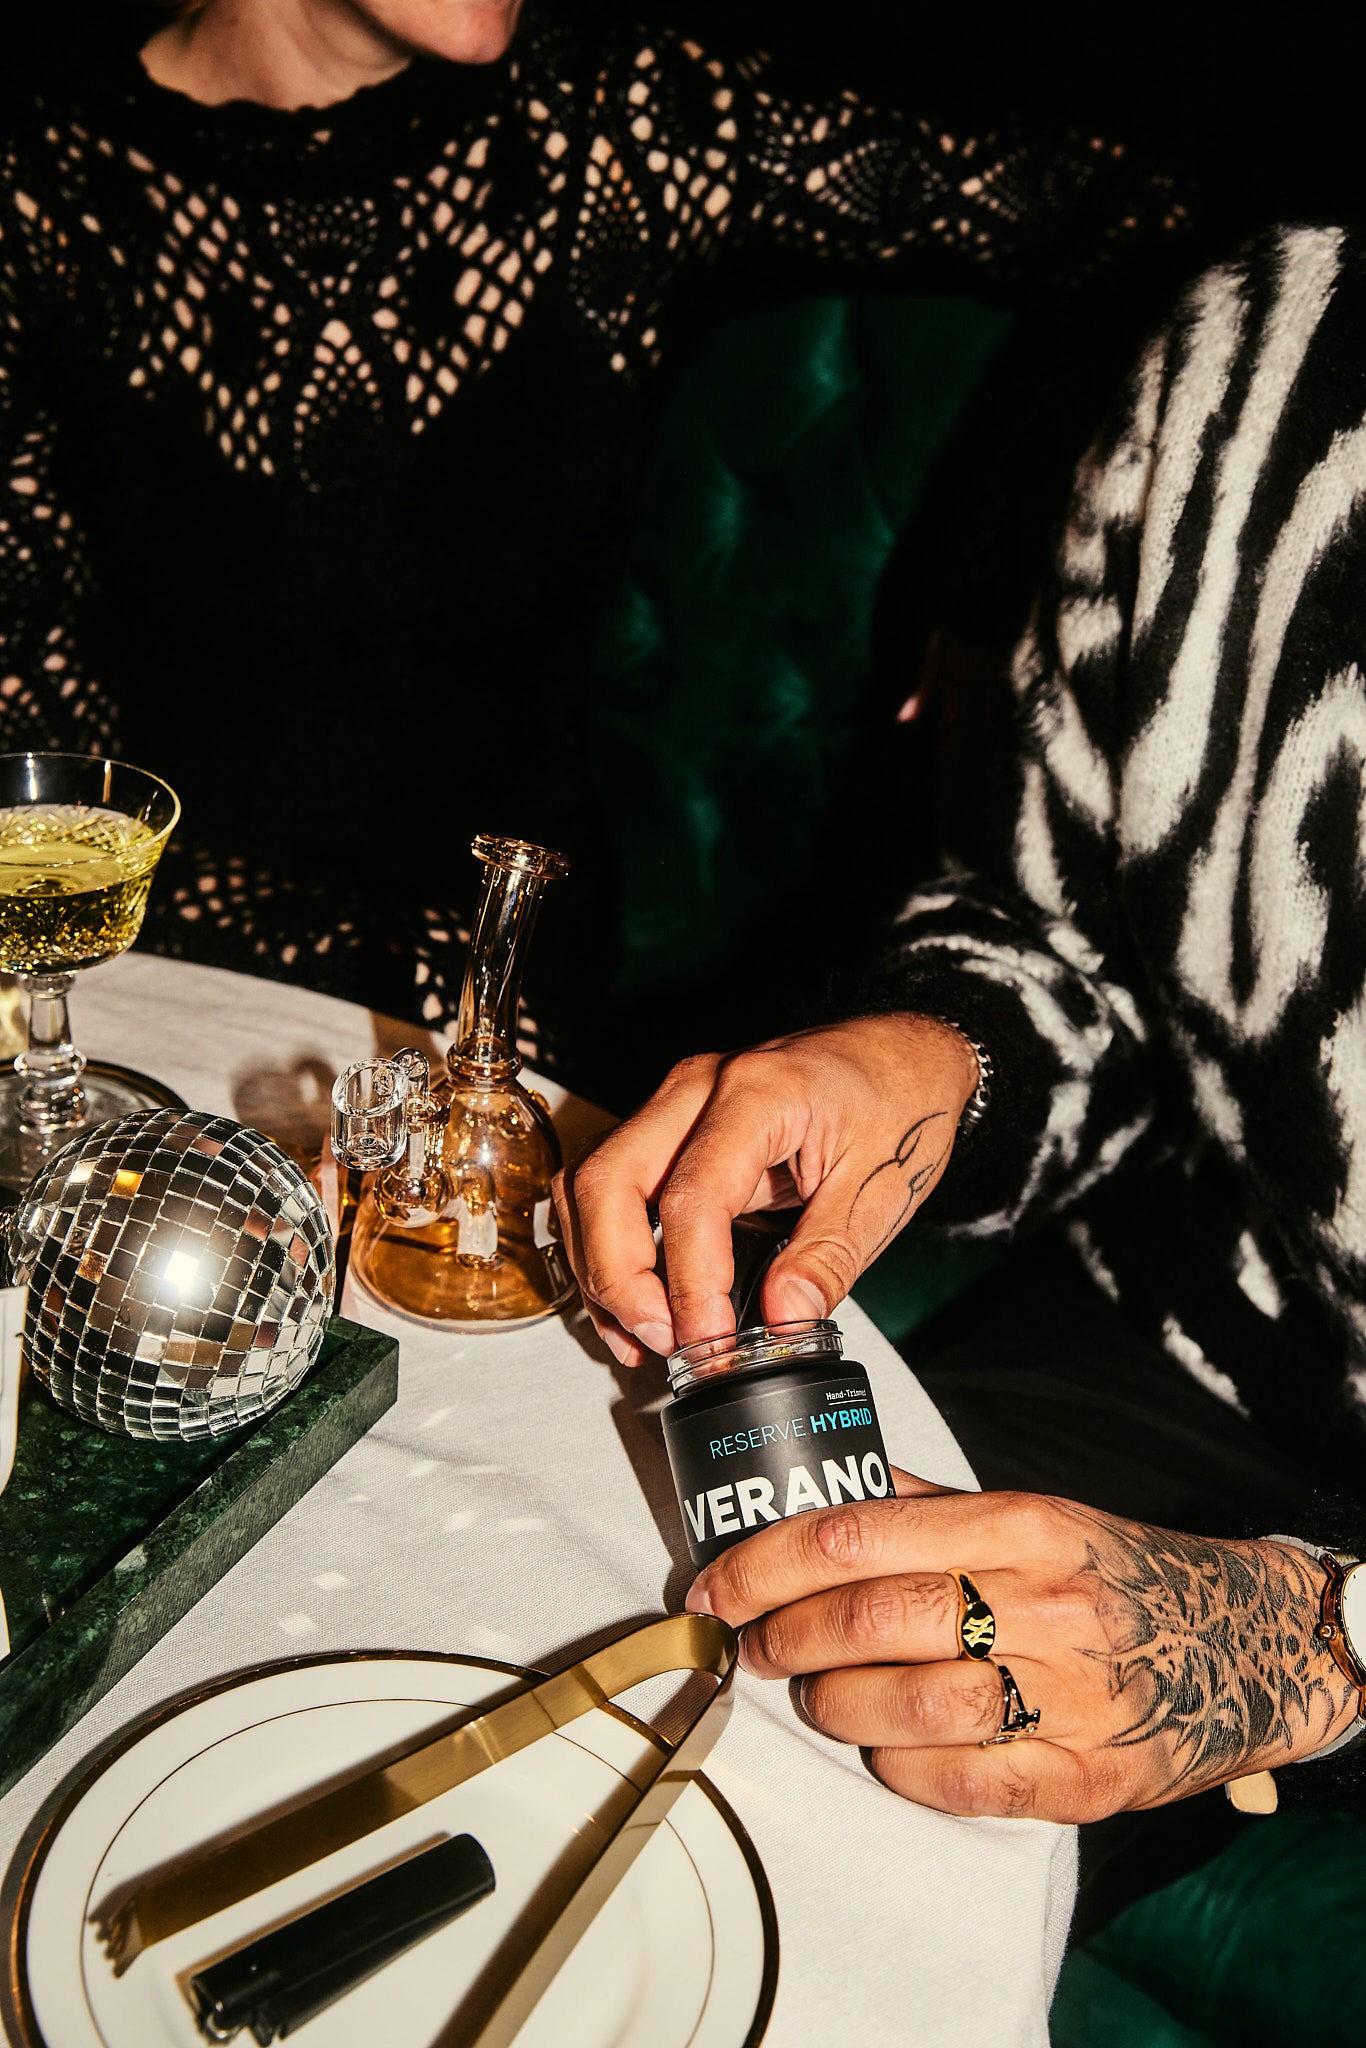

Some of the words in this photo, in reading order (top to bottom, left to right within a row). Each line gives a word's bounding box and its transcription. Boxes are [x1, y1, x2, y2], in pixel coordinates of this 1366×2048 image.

[709, 1418, 806, 1459] RESERVE
[810, 1407, 872, 1433] HYBRID
[684, 1451, 887, 1542] VERANO
